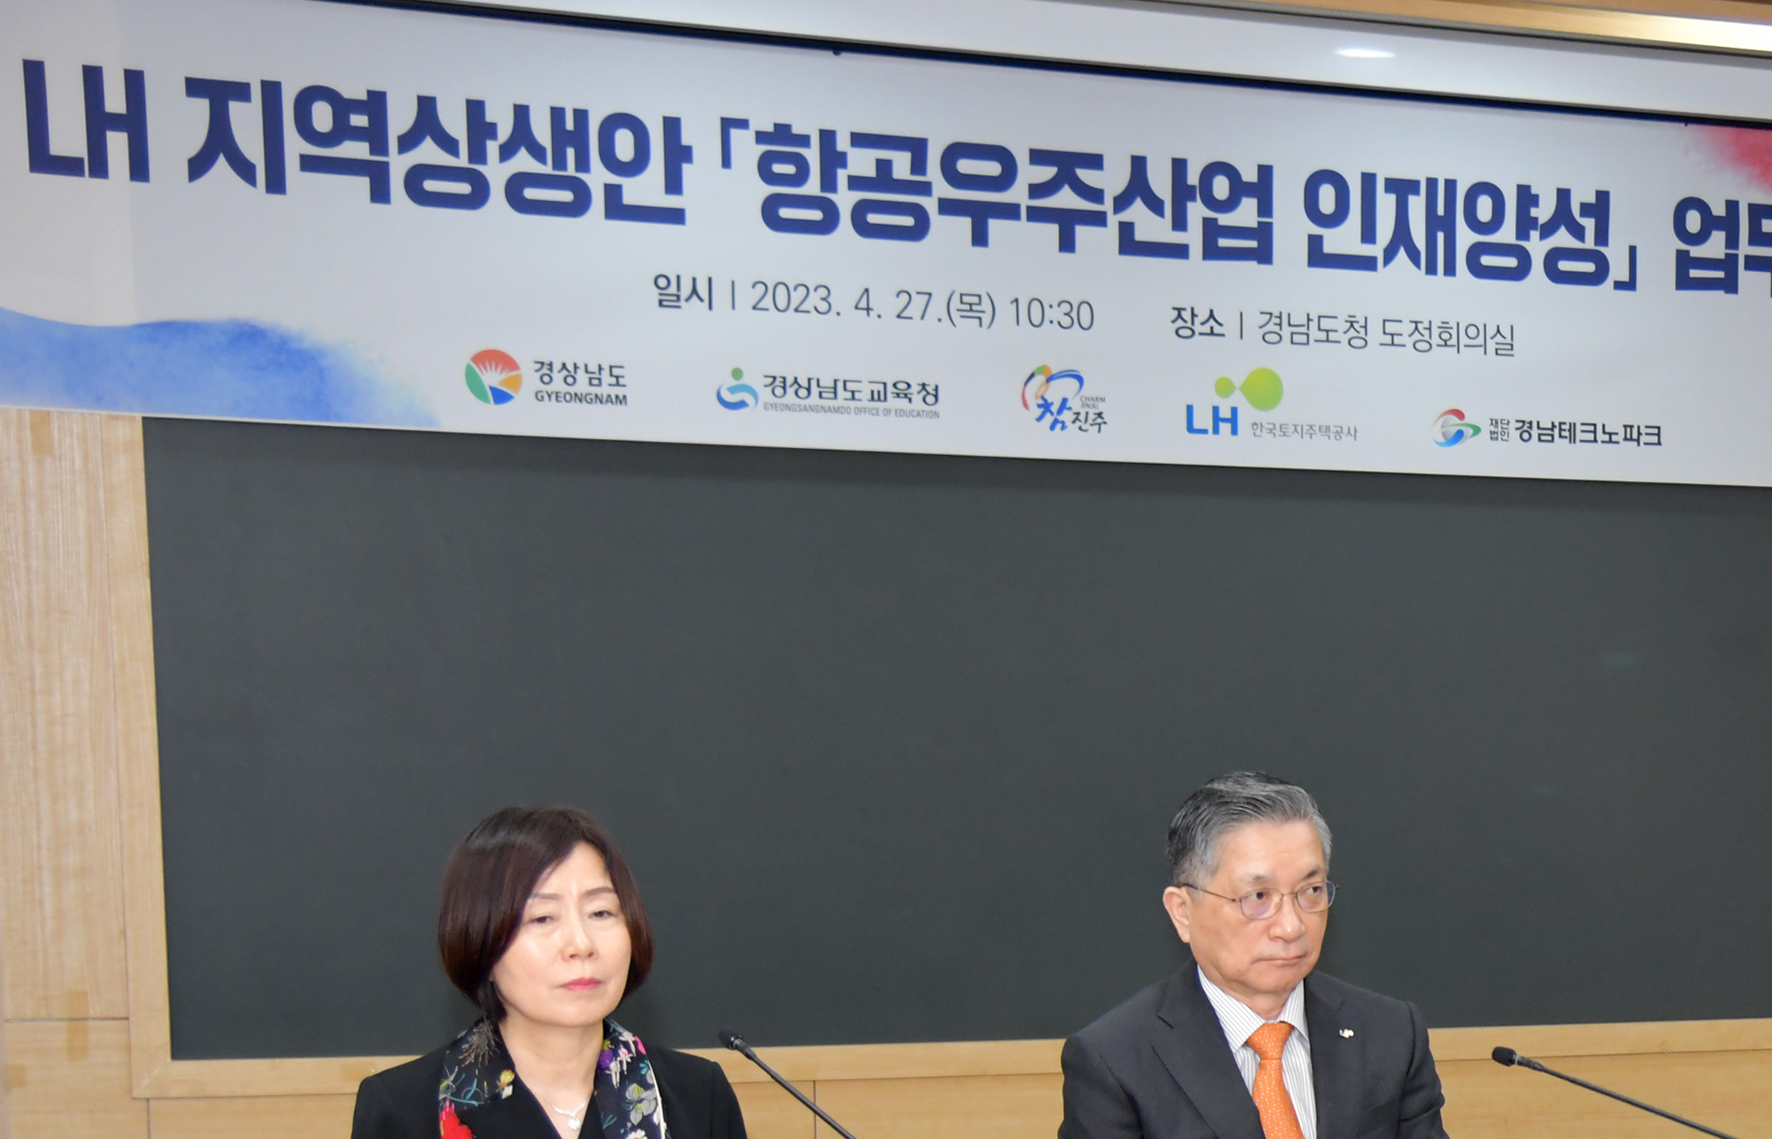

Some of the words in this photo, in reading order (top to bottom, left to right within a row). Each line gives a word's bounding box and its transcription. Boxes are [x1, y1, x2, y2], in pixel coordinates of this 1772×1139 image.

[184, 76, 693, 226] 지역상생안
[653, 274, 713, 311] 일시
[751, 281, 841, 317] 2023.
[854, 287, 882, 319] 4.
[1010, 298, 1094, 331] 10:30
[1170, 306, 1225, 339] 장소
[1258, 310, 1369, 350] 경남도청
[1379, 317, 1515, 357] 도정회의실
[533, 359, 627, 388] 경상남도
[534, 389, 627, 406] GYEONGNAM
[763, 374, 940, 407] 경상남도교육청
[763, 402, 852, 416] GYEONGSANGNAMDO
[854, 407, 881, 417] OFFICE
[883, 408, 893, 417] OF
[895, 409, 940, 419] EDUCATION
[1071, 411, 1108, 433] 진주
[1186, 404, 1239, 436] LH
[1251, 421, 1359, 442] 한국토지주택공사
[1514, 419, 1663, 447] 경남테크노파크
